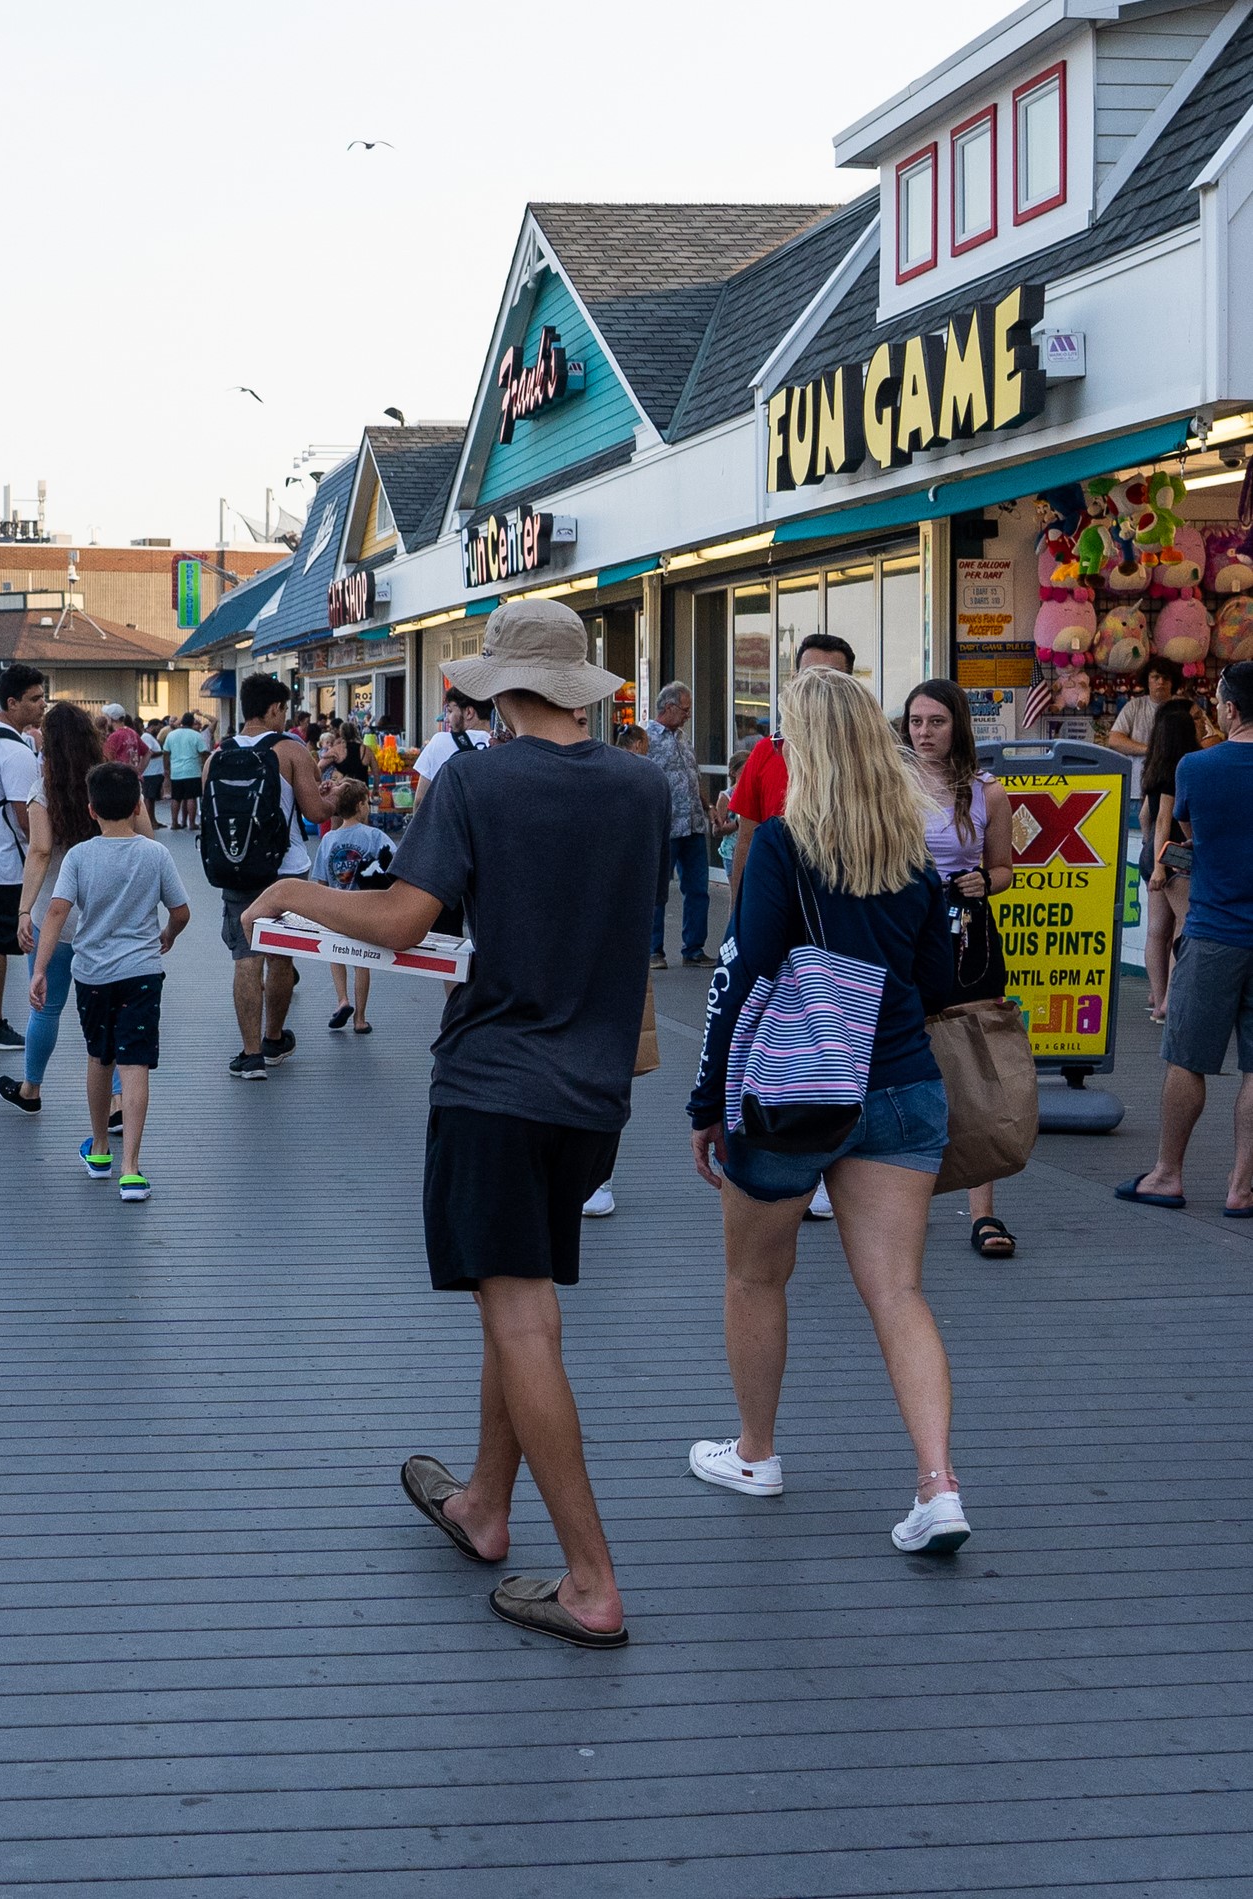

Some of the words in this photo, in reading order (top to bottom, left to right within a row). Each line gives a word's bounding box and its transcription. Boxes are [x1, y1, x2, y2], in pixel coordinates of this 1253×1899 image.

[498, 327, 559, 444] Frank's
[767, 365, 850, 493] FUN
[863, 286, 1029, 470] GAME
[461, 527, 487, 588] Fun
[488, 505, 541, 581] Center
[958, 561, 976, 570] ONE
[977, 561, 1011, 570] BALLOON
[964, 571, 982, 580] PER
[982, 571, 1003, 580] DART
[344, 571, 368, 623] SHOP
[967, 624, 1005, 636] ACCEPTED
[959, 643, 980, 652] DART
[981, 643, 1003, 652] GAME
[1005, 643, 1031, 652] RULES
[997, 775, 1069, 787] ERVEZA
[1011, 872, 1089, 890] EQUIS
[999, 903, 1073, 927] PRICED
[999, 931, 1039, 956] UIS
[1045, 931, 1106, 956] PINTS
[332, 944, 350, 955] fresh
[350, 945, 363, 957] hot
[363, 949, 381, 960] pizza
[1049, 970, 1081, 986] 6PM
[1085, 970, 1106, 986] AT
[1053, 1043, 1082, 1051] GRILL
